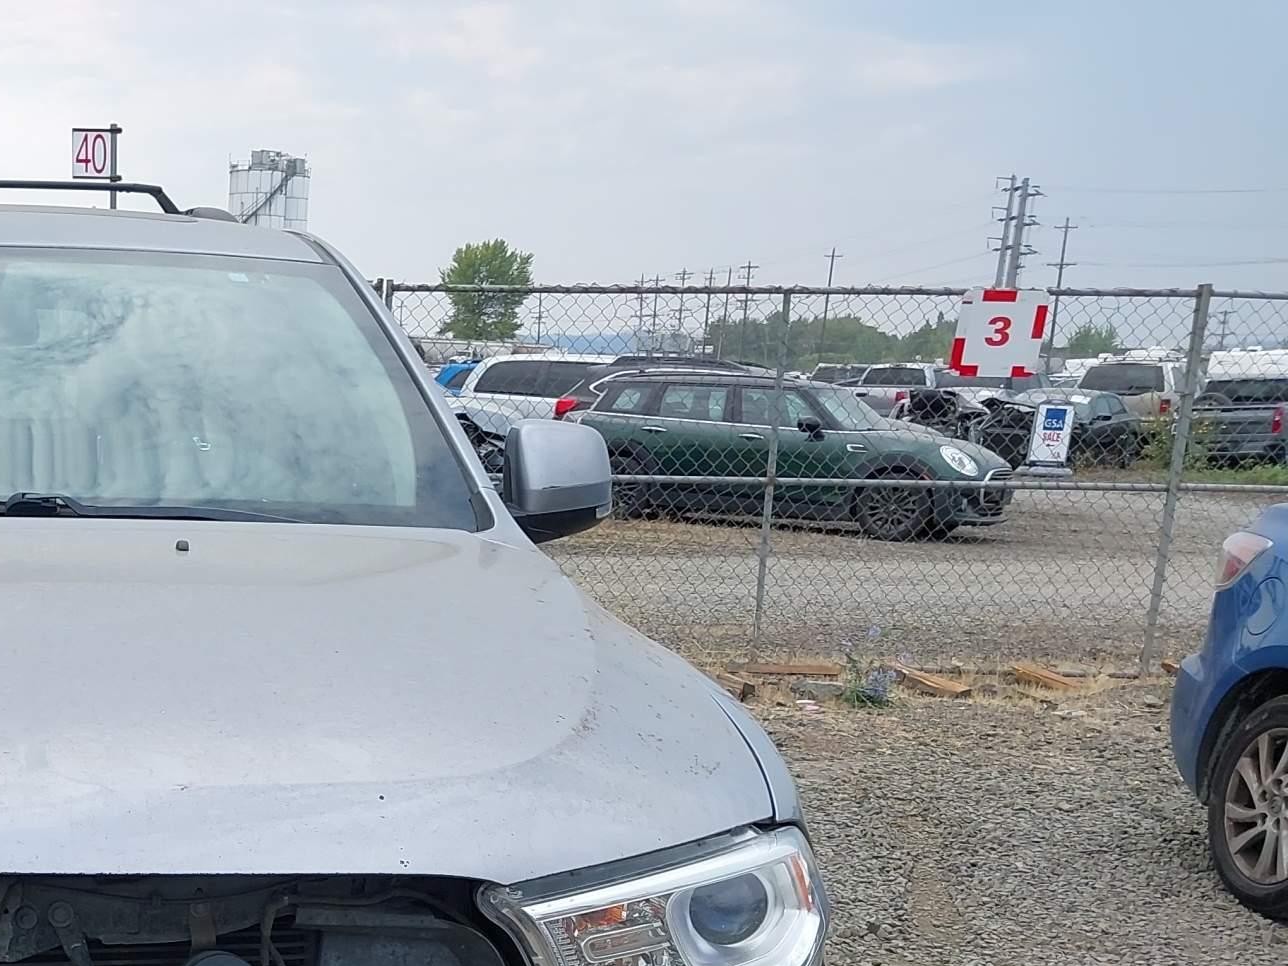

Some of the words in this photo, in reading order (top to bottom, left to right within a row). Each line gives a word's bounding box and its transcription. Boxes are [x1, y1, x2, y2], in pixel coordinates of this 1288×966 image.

[75, 133, 107, 174] 40
[984, 316, 1012, 347] 3
[1044, 418, 1063, 429] GSA
[1042, 431, 1062, 443] SALE
